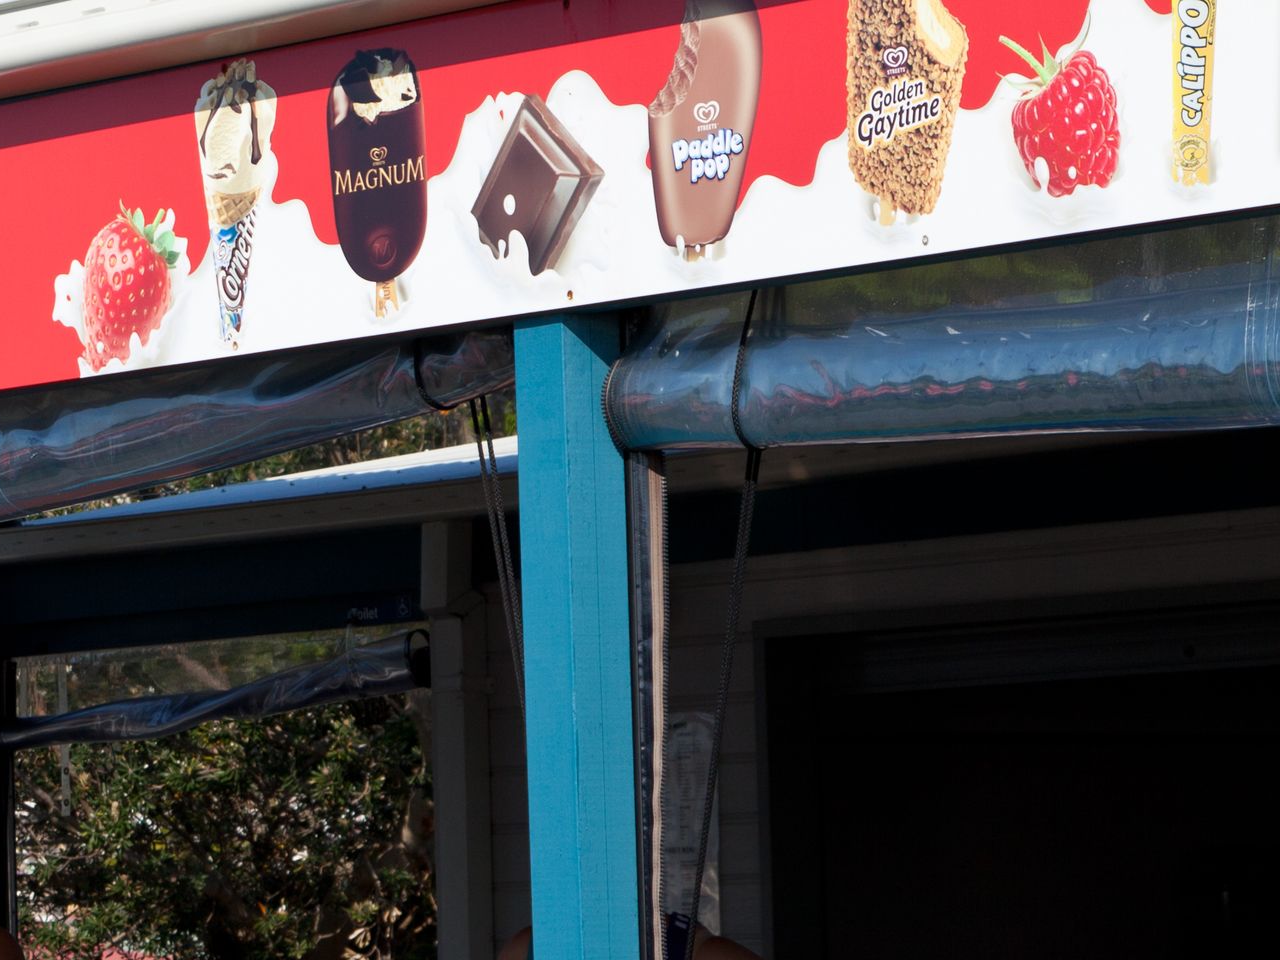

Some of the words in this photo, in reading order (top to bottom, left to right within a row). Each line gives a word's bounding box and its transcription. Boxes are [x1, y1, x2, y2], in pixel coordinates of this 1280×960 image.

[871, 81, 924, 115] Golden
[858, 98, 940, 146] Gaytime
[334, 155, 425, 195] MAGNUM
[691, 153, 730, 184] pop
